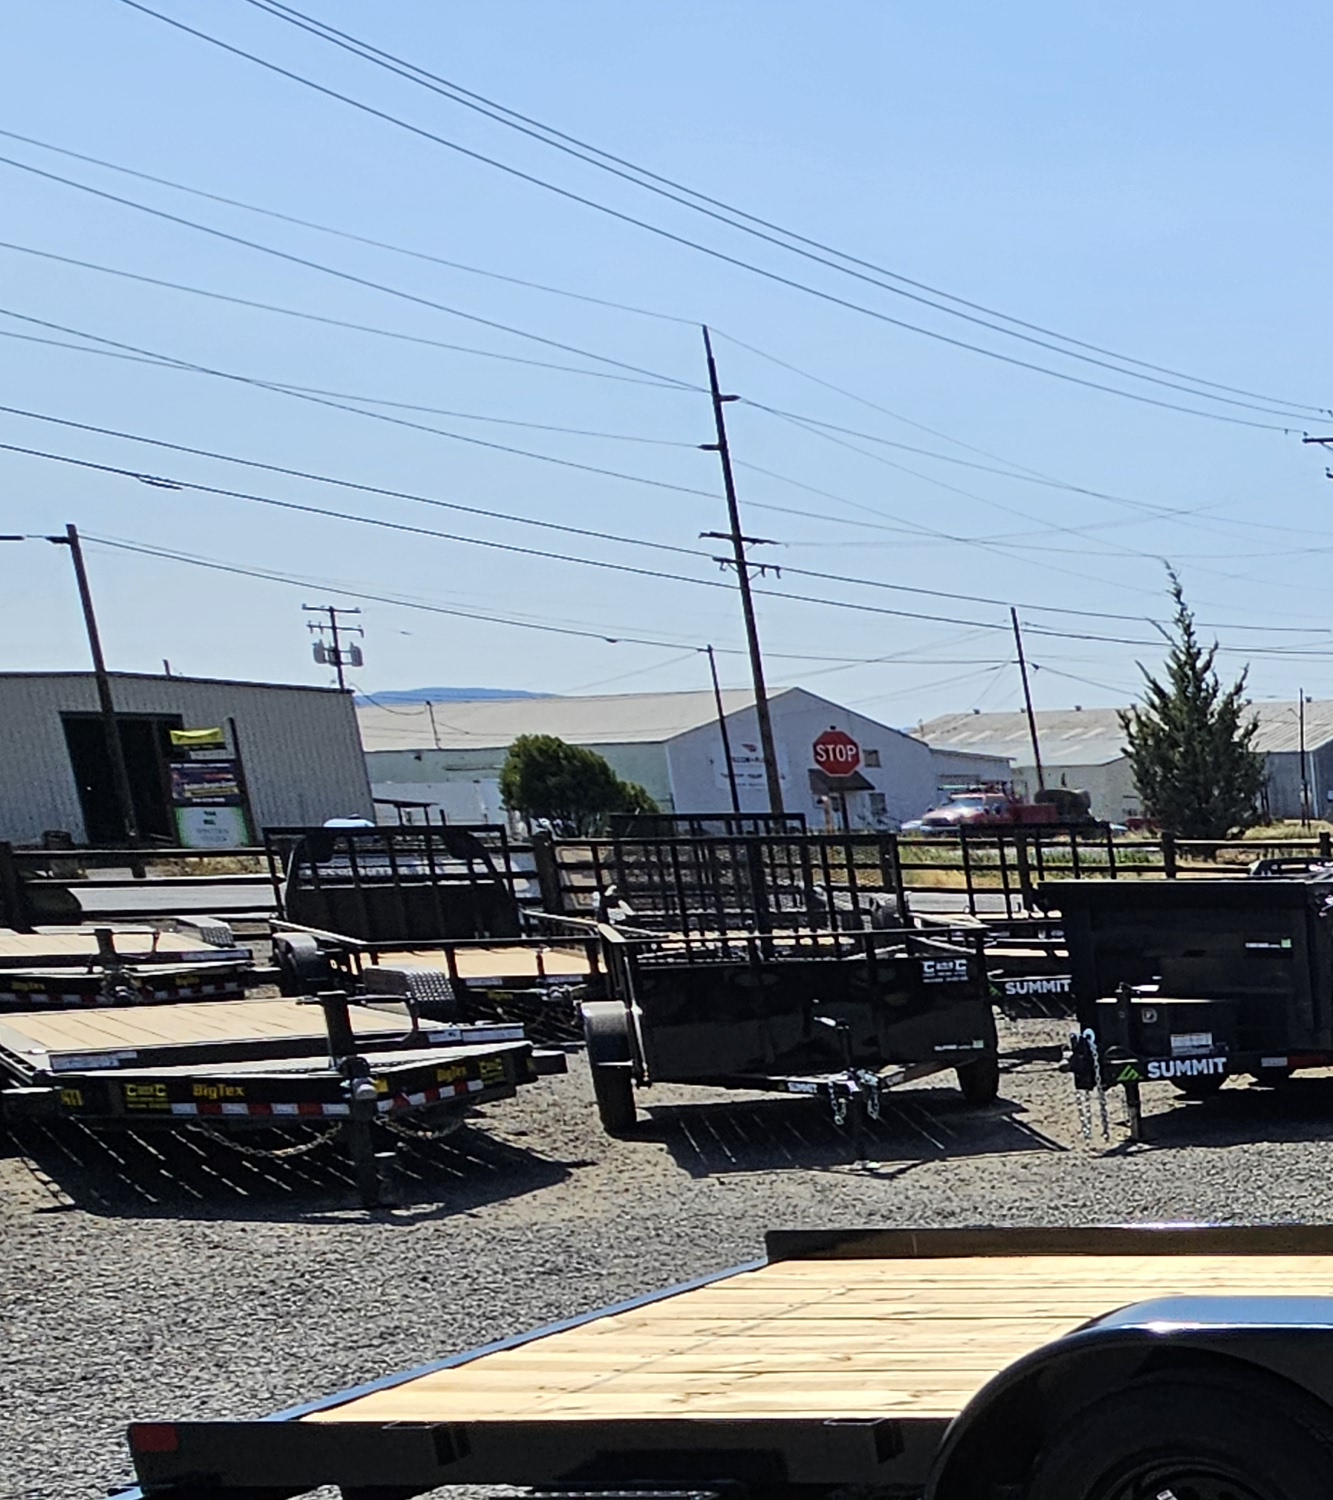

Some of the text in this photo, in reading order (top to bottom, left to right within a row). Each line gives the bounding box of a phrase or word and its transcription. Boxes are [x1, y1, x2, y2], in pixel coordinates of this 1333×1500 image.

[815, 744, 857, 762] STOP
[1004, 979, 1072, 995] SUMMIT
[1147, 1057, 1227, 1079] SUMMIT
[192, 1084, 246, 1099] BigTex
